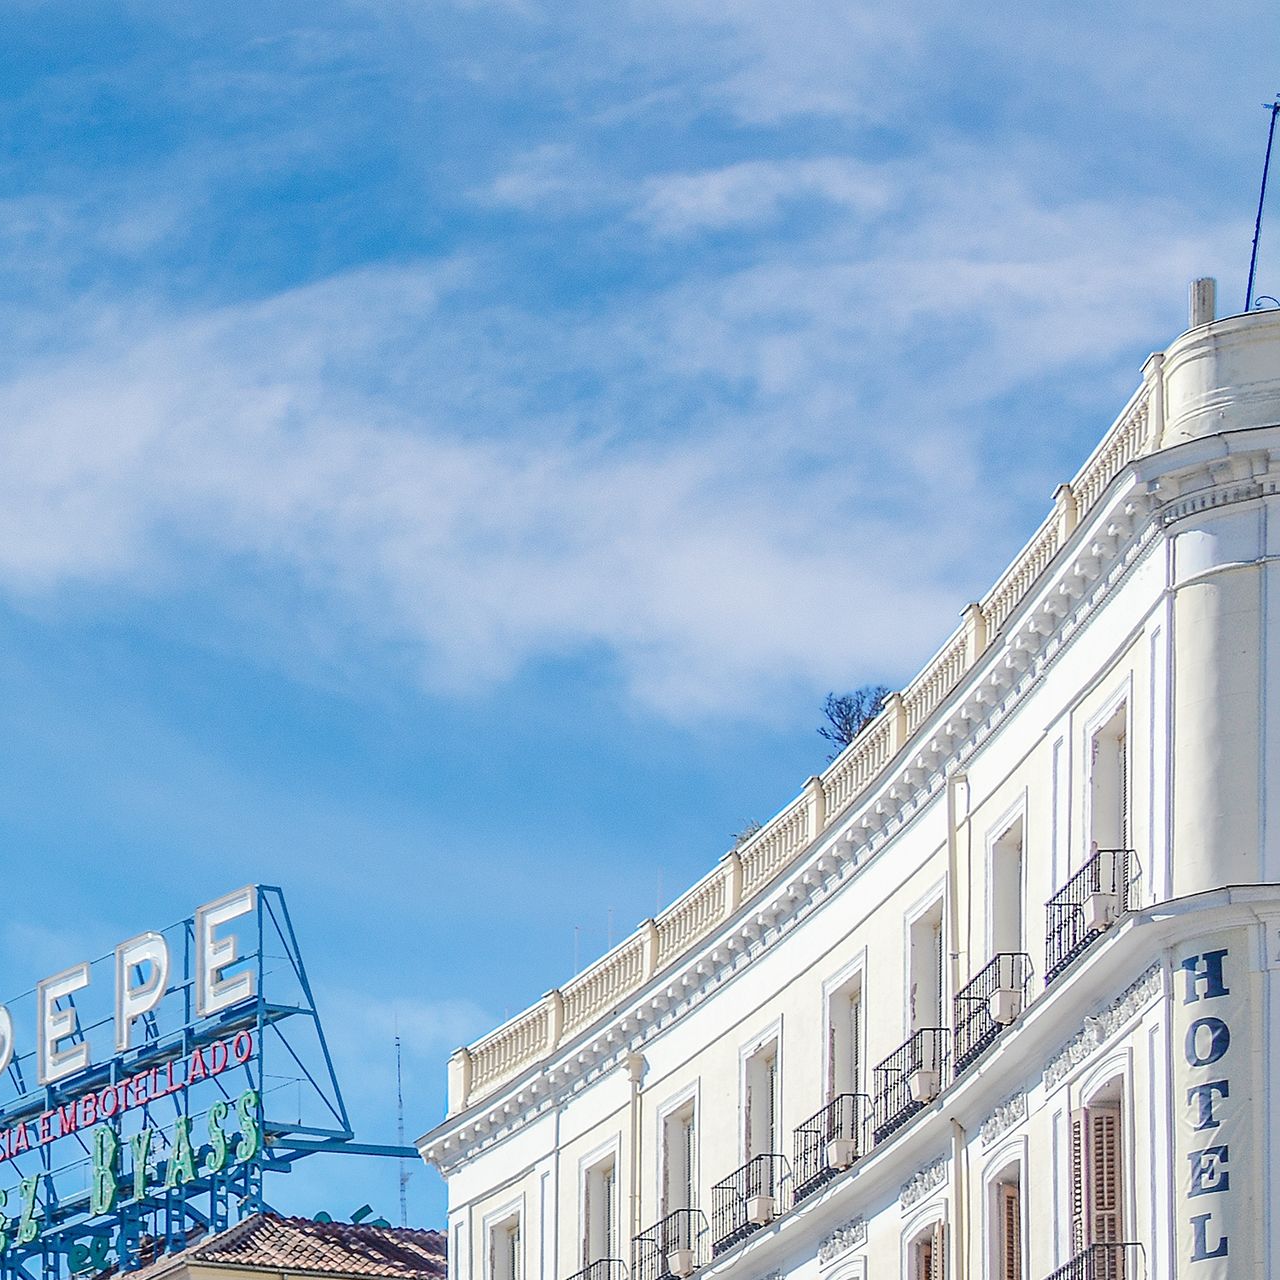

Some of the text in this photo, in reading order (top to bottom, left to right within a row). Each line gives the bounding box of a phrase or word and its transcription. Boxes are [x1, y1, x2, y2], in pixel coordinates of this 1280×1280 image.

[40, 1030, 252, 1144] EMBOTELLADO
[1181, 948, 1231, 1266] HOTEL
[91, 1088, 259, 1216] BYASS
